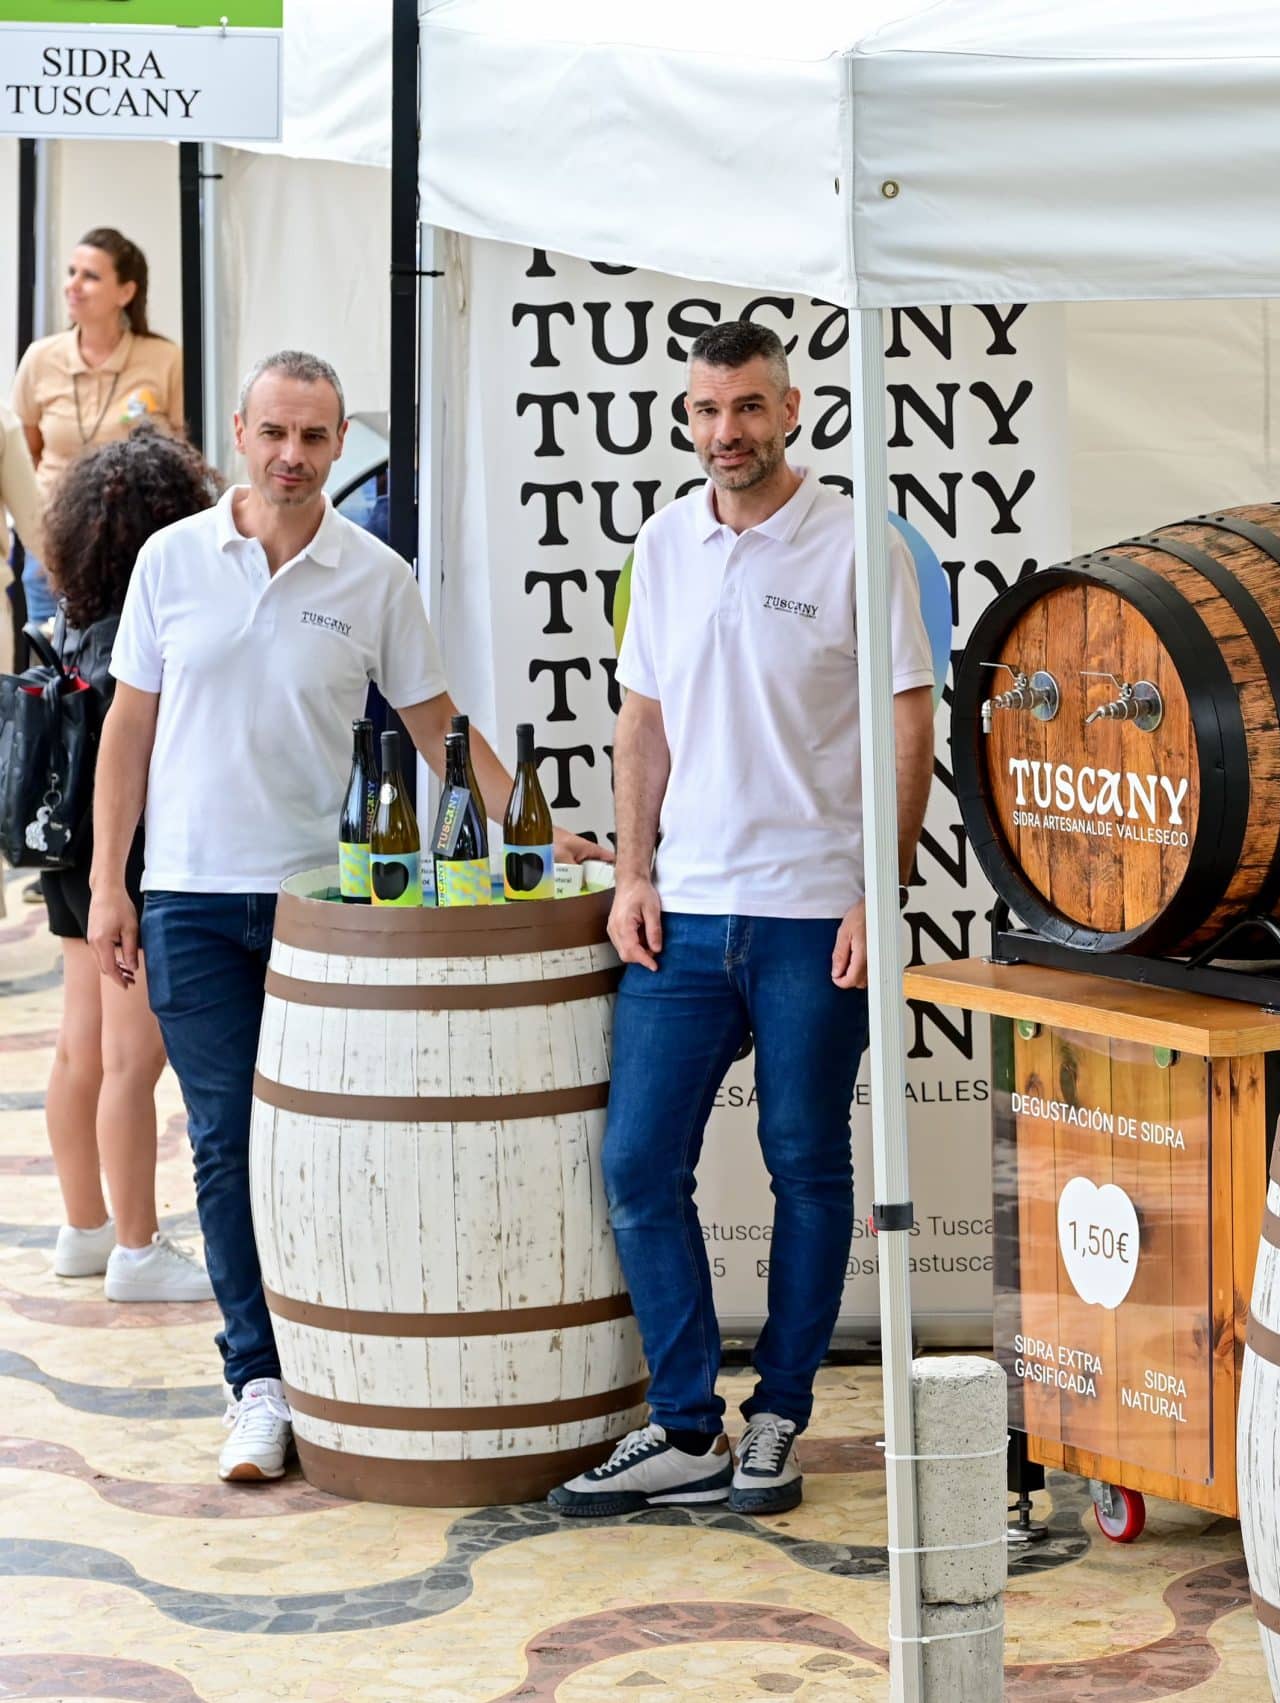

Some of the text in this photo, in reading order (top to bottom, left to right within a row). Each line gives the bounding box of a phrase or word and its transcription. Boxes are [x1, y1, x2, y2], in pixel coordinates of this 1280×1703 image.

[42, 47, 166, 79] SIDRA
[6, 84, 202, 118] TUSCANY
[1012, 810, 1041, 828] SIDRA
[1116, 823, 1189, 847] VALLESECO
[1011, 1092, 1186, 1150] DEGUSTACIÓN DE SIDRA
[927, 1215, 993, 1237] Tusca
[1068, 1220, 1129, 1264] 1,50€
[1014, 1333, 1104, 1376] SIDRA EXTRA
[1014, 1358, 1097, 1399] GASIFICADA
[1144, 1369, 1188, 1399] SIDRA
[1121, 1387, 1188, 1424] NATURAL
